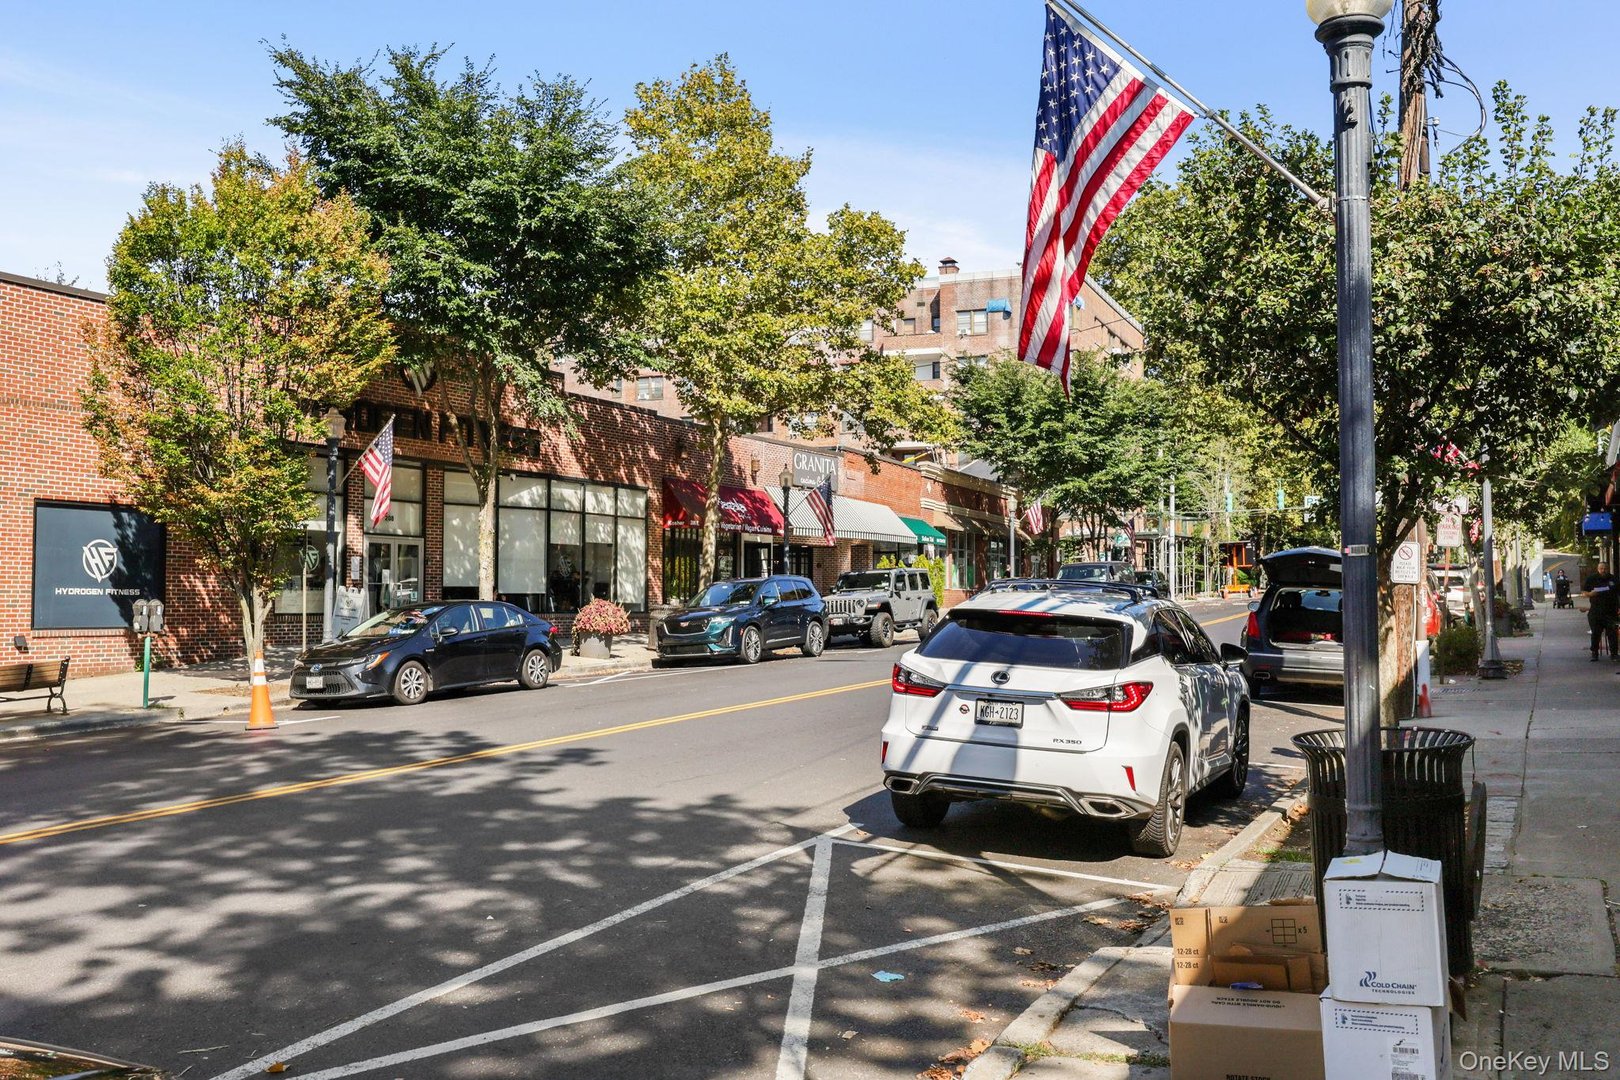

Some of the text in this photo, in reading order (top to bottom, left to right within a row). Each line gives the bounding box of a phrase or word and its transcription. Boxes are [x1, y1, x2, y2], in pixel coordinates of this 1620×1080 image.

[794, 452, 837, 475] GRANITA
[721, 523, 742, 531] Vegetarian
[55, 587, 140, 596] HYDROGEN FITNESS
[1371, 981, 1415, 990] COLD CHAIN
